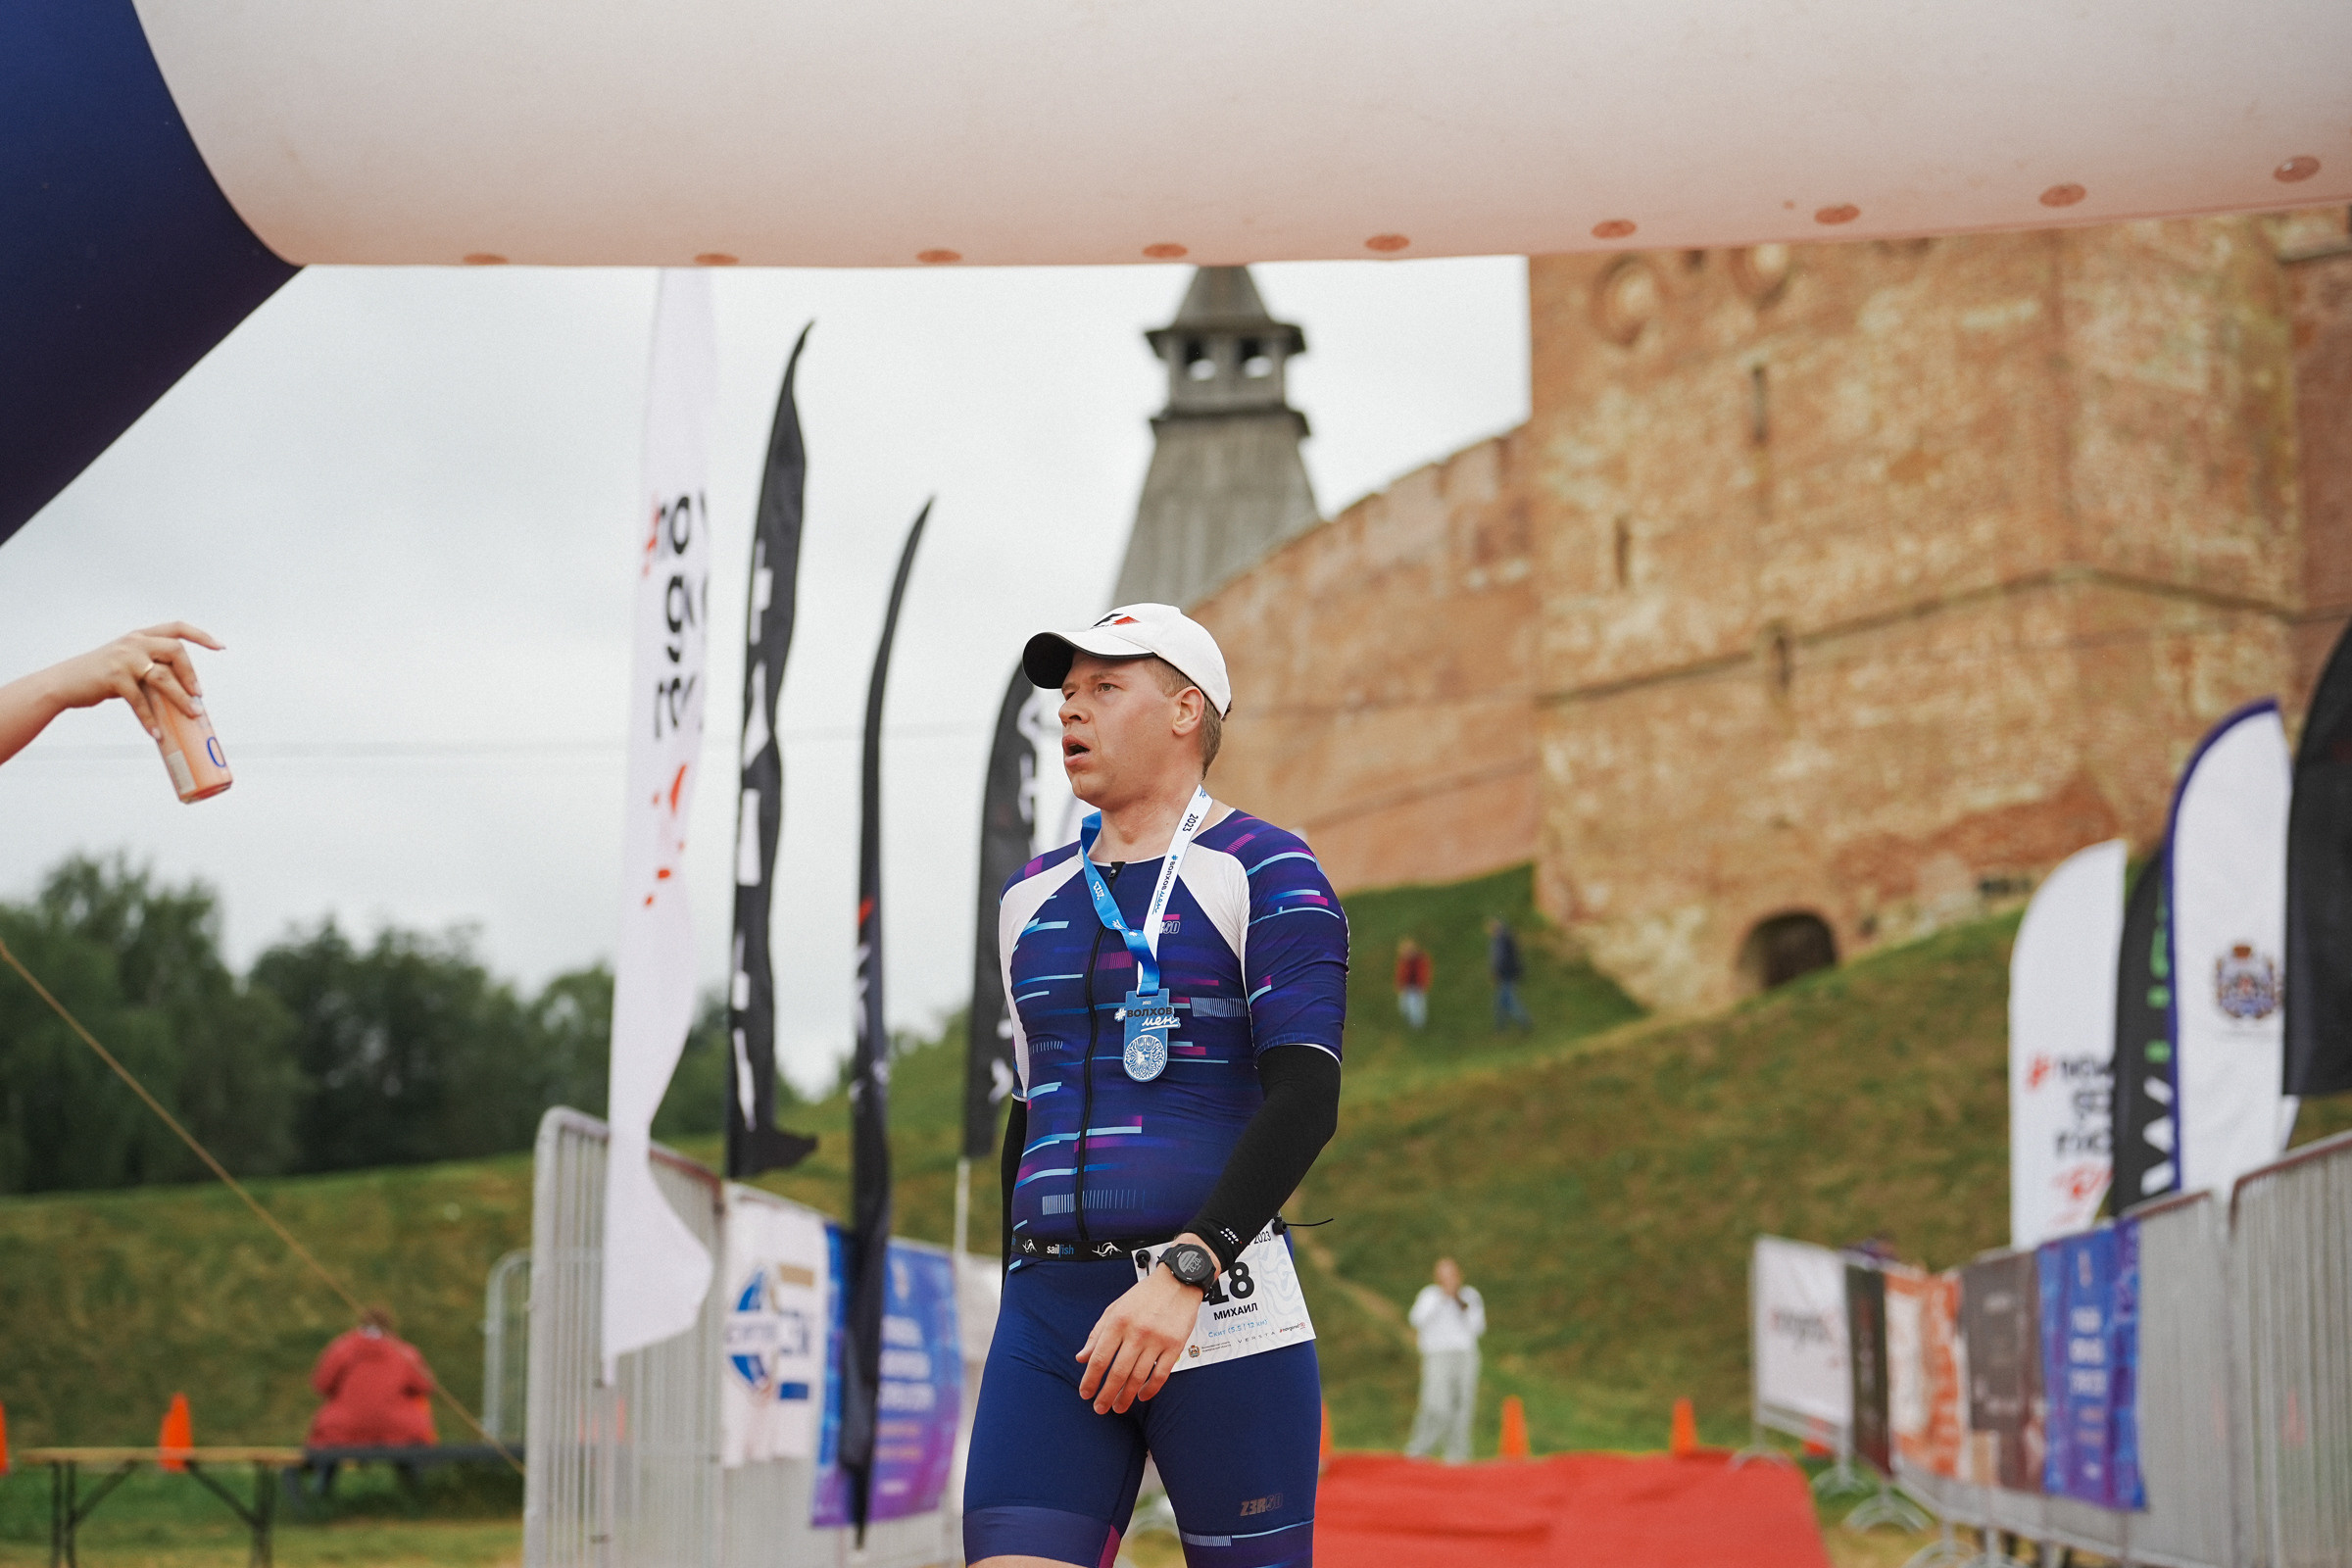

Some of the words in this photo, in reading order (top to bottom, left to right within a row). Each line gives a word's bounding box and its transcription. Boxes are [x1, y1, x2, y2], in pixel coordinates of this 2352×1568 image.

[1182, 813, 1199, 832] 2023
[1114, 1006, 1173, 1021] #ВОЛХОВ
[1141, 1015, 1179, 1028] мен
[1254, 1231, 1272, 1245] 2023
[1047, 1244, 1074, 1258] sailfish
[1213, 1302, 1258, 1321] МИХАИЛ
[1238, 1331, 1275, 1344] VERSTA
